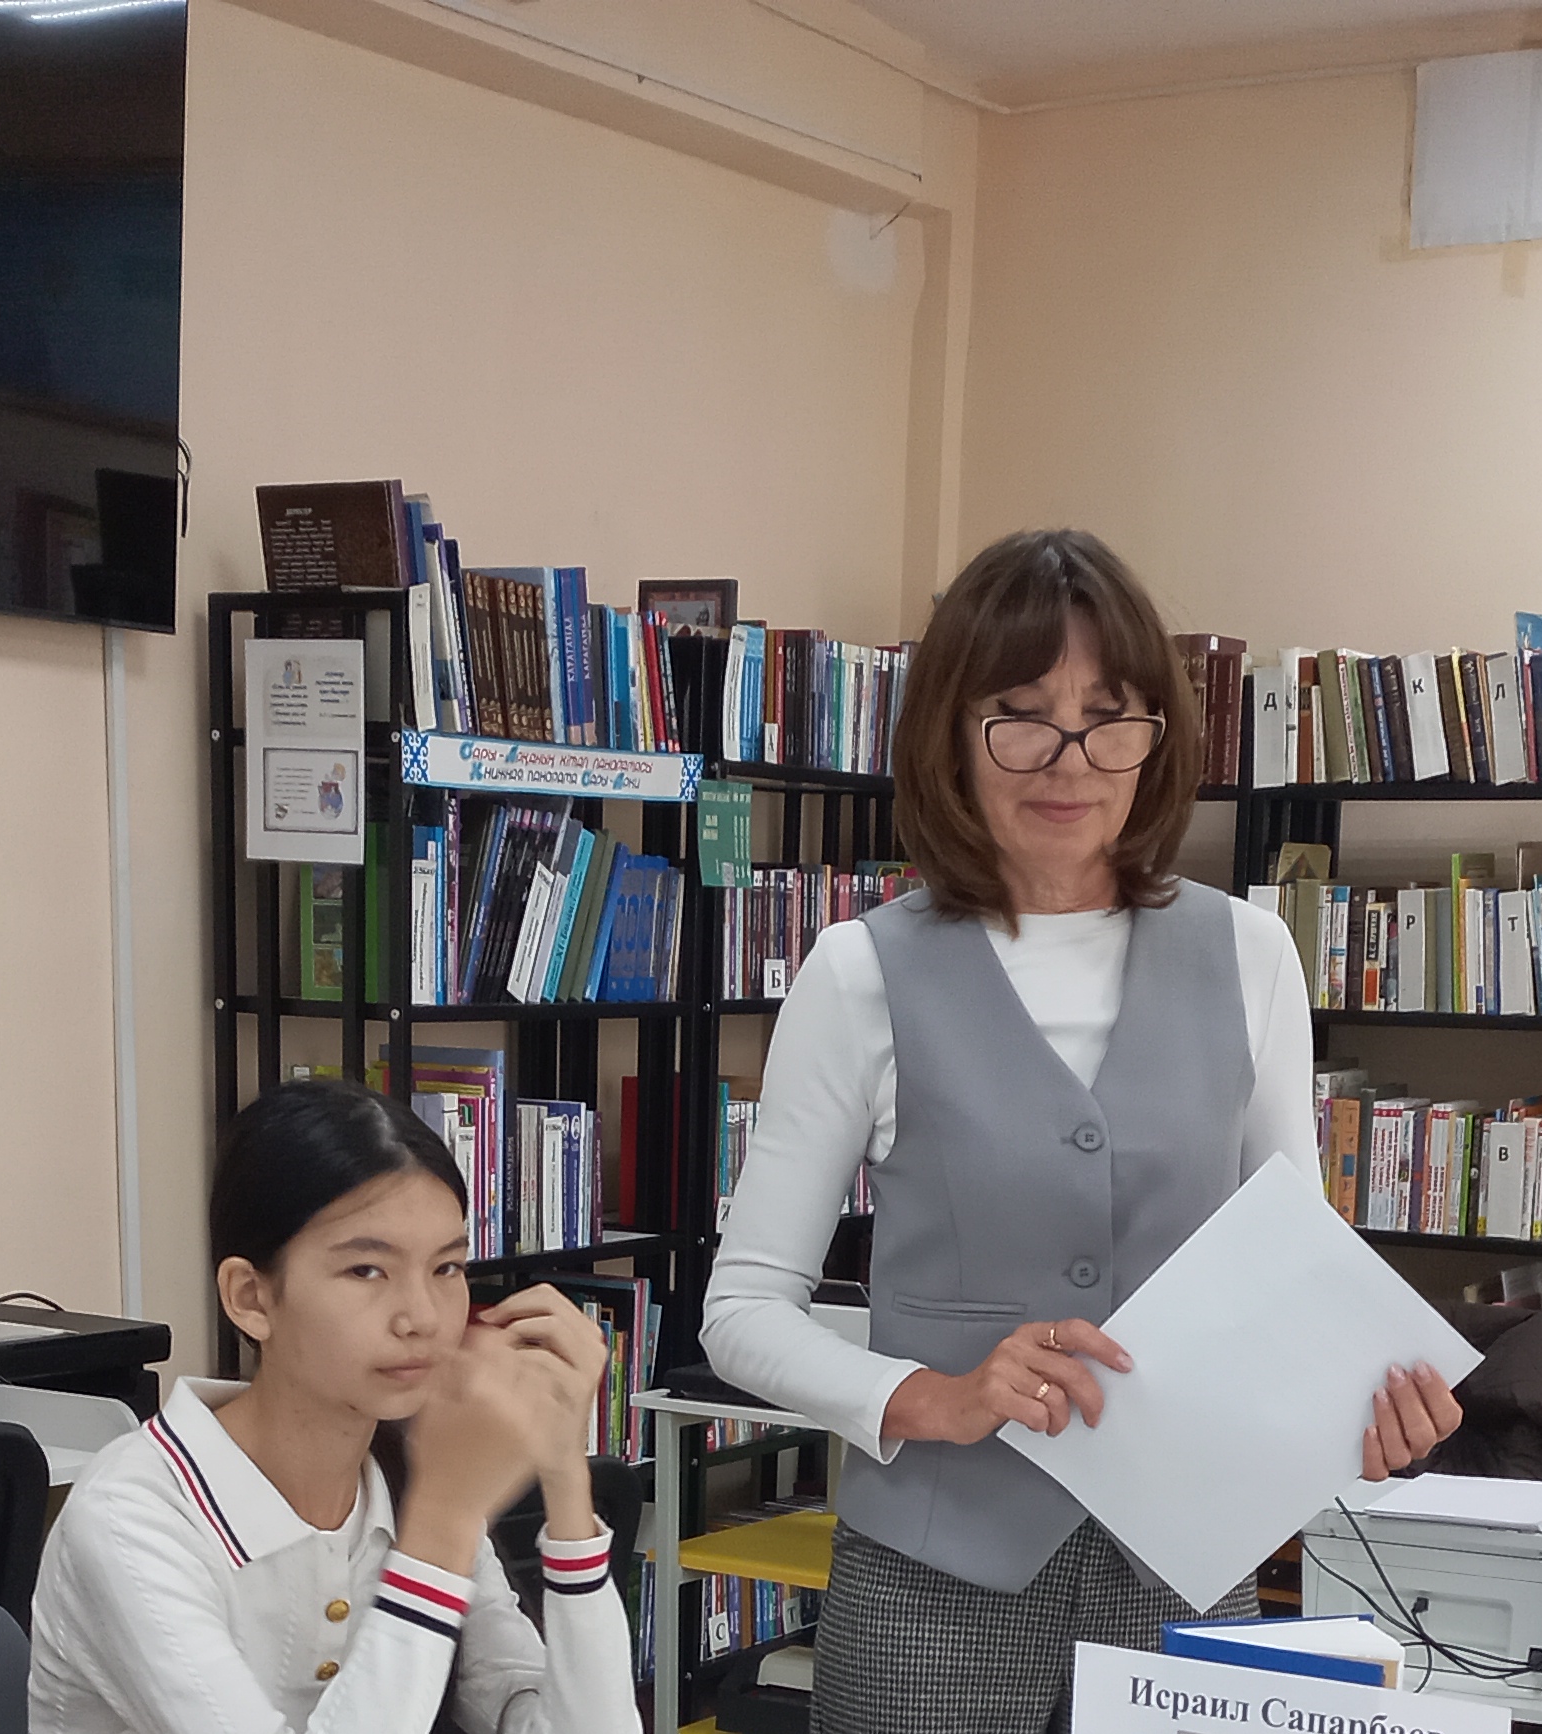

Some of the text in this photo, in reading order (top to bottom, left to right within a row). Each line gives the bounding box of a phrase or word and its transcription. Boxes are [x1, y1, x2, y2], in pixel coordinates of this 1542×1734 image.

[1412, 677, 1424, 695] К
[1494, 682, 1506, 701] Л
[1264, 691, 1277, 711] Д
[768, 735, 776, 751] А
[1405, 914, 1416, 931] Р
[1507, 916, 1519, 932] Т
[771, 968, 782, 990] Б
[1498, 1146, 1509, 1162] В
[787, 1605, 798, 1625] Т
[715, 1621, 727, 1642] С
[1129, 1675, 1250, 1720] Исраил
